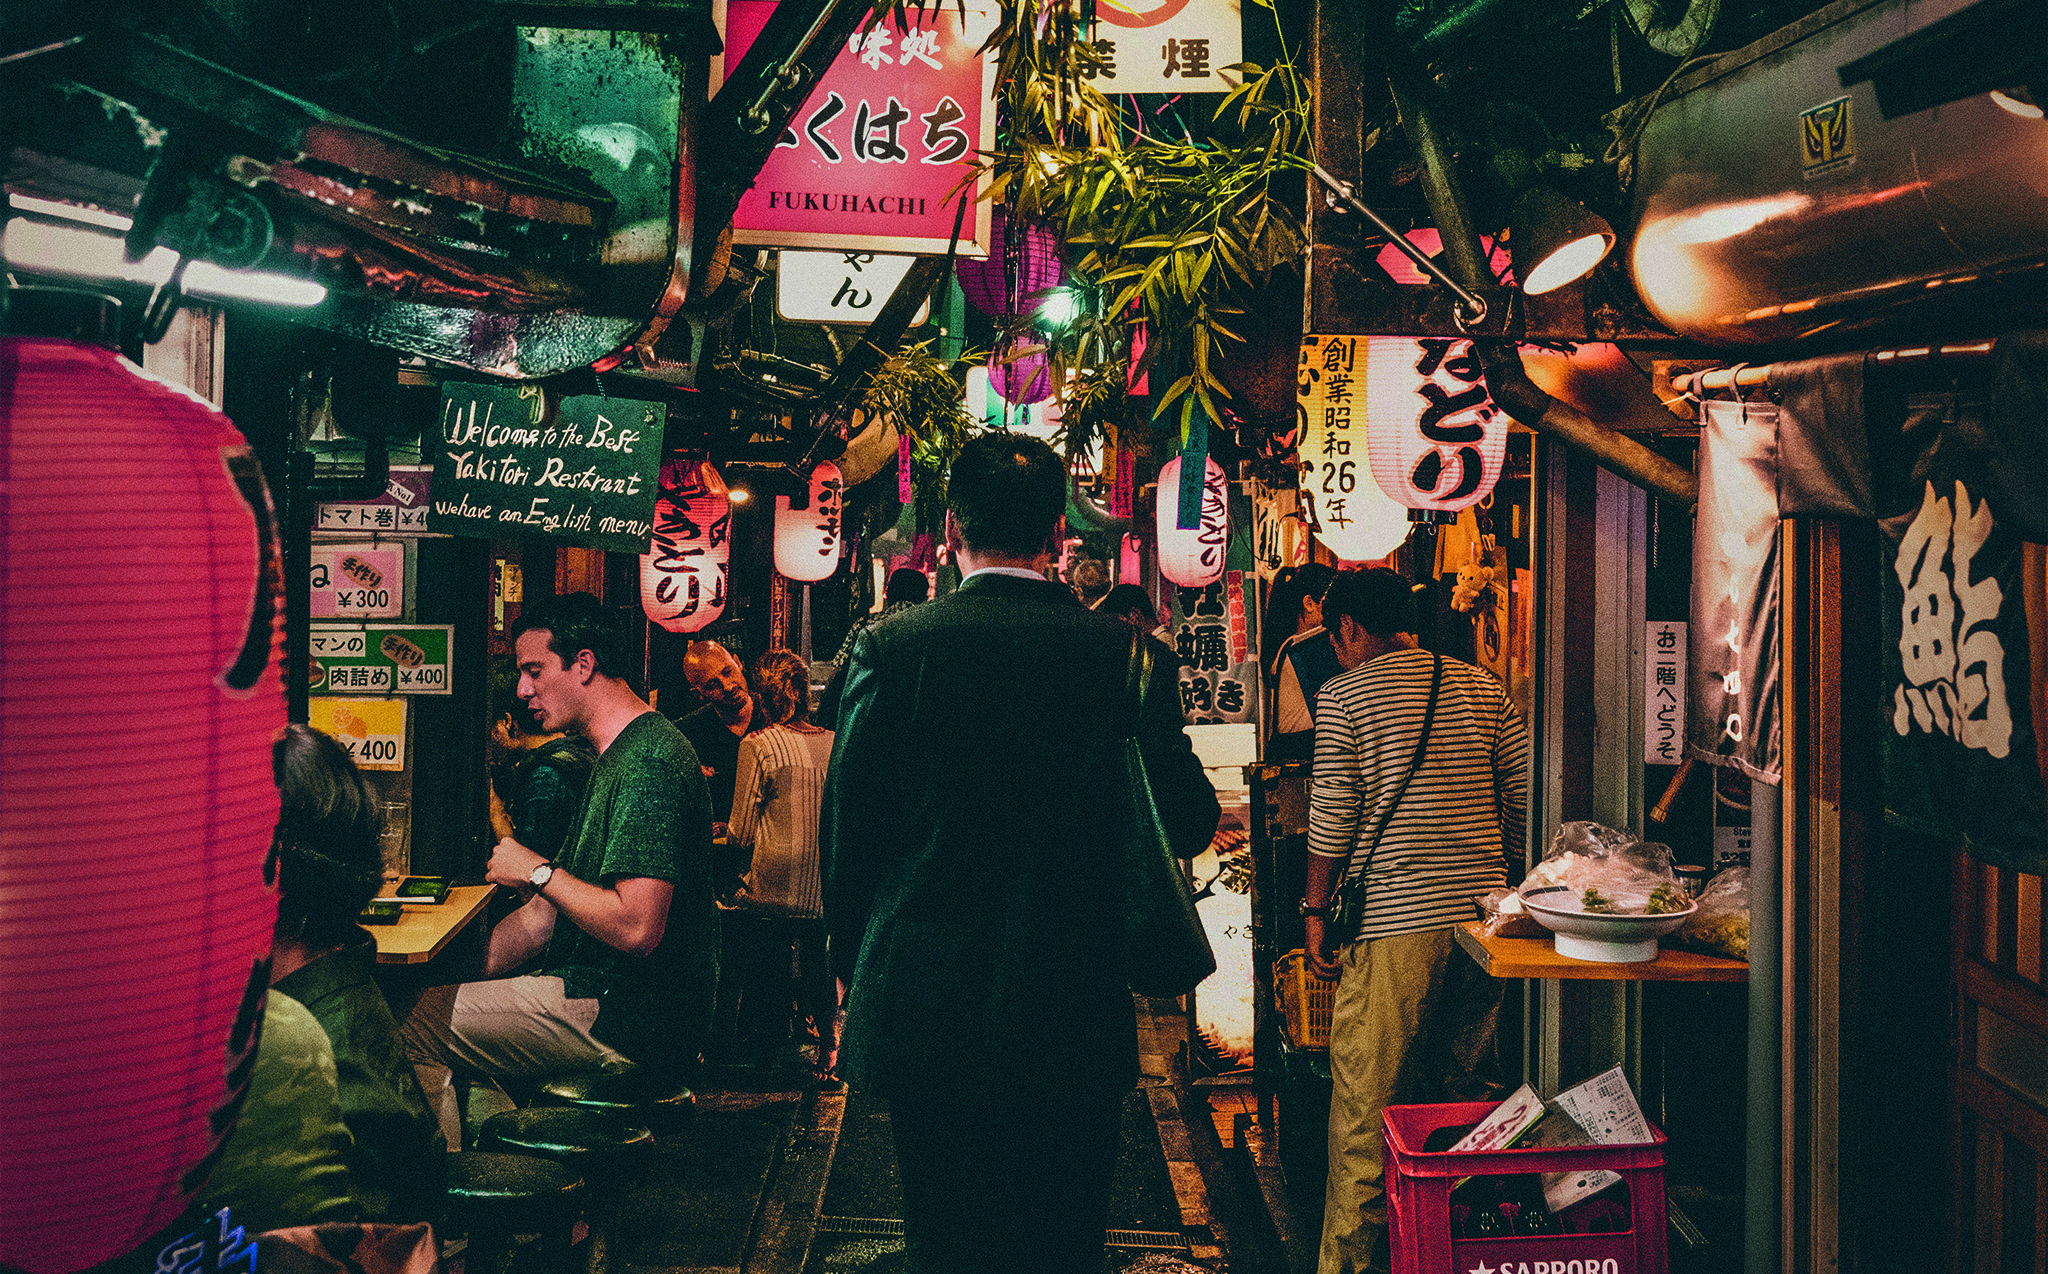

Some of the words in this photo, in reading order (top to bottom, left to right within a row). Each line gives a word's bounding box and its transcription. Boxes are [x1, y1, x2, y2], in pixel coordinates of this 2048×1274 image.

[849, 22, 943, 70] 味処
[775, 91, 970, 165] くはち
[769, 191, 927, 216] FUKUHACHI
[443, 398, 540, 448] Welcome
[541, 426, 555, 448] to
[559, 423, 583, 448] the
[585, 414, 640, 453] Best
[1322, 337, 1356, 531] 創業昭和26年
[320, 507, 394, 528] トマト巻
[342, 557, 382, 588] 手作り
[337, 589, 389, 608] ¥300
[1894, 478, 2013, 760] 鮨
[311, 637, 364, 652] マンの
[383, 636, 423, 666] 手作り
[330, 668, 389, 687] 肉詰め
[400, 668, 443, 685] ¥400
